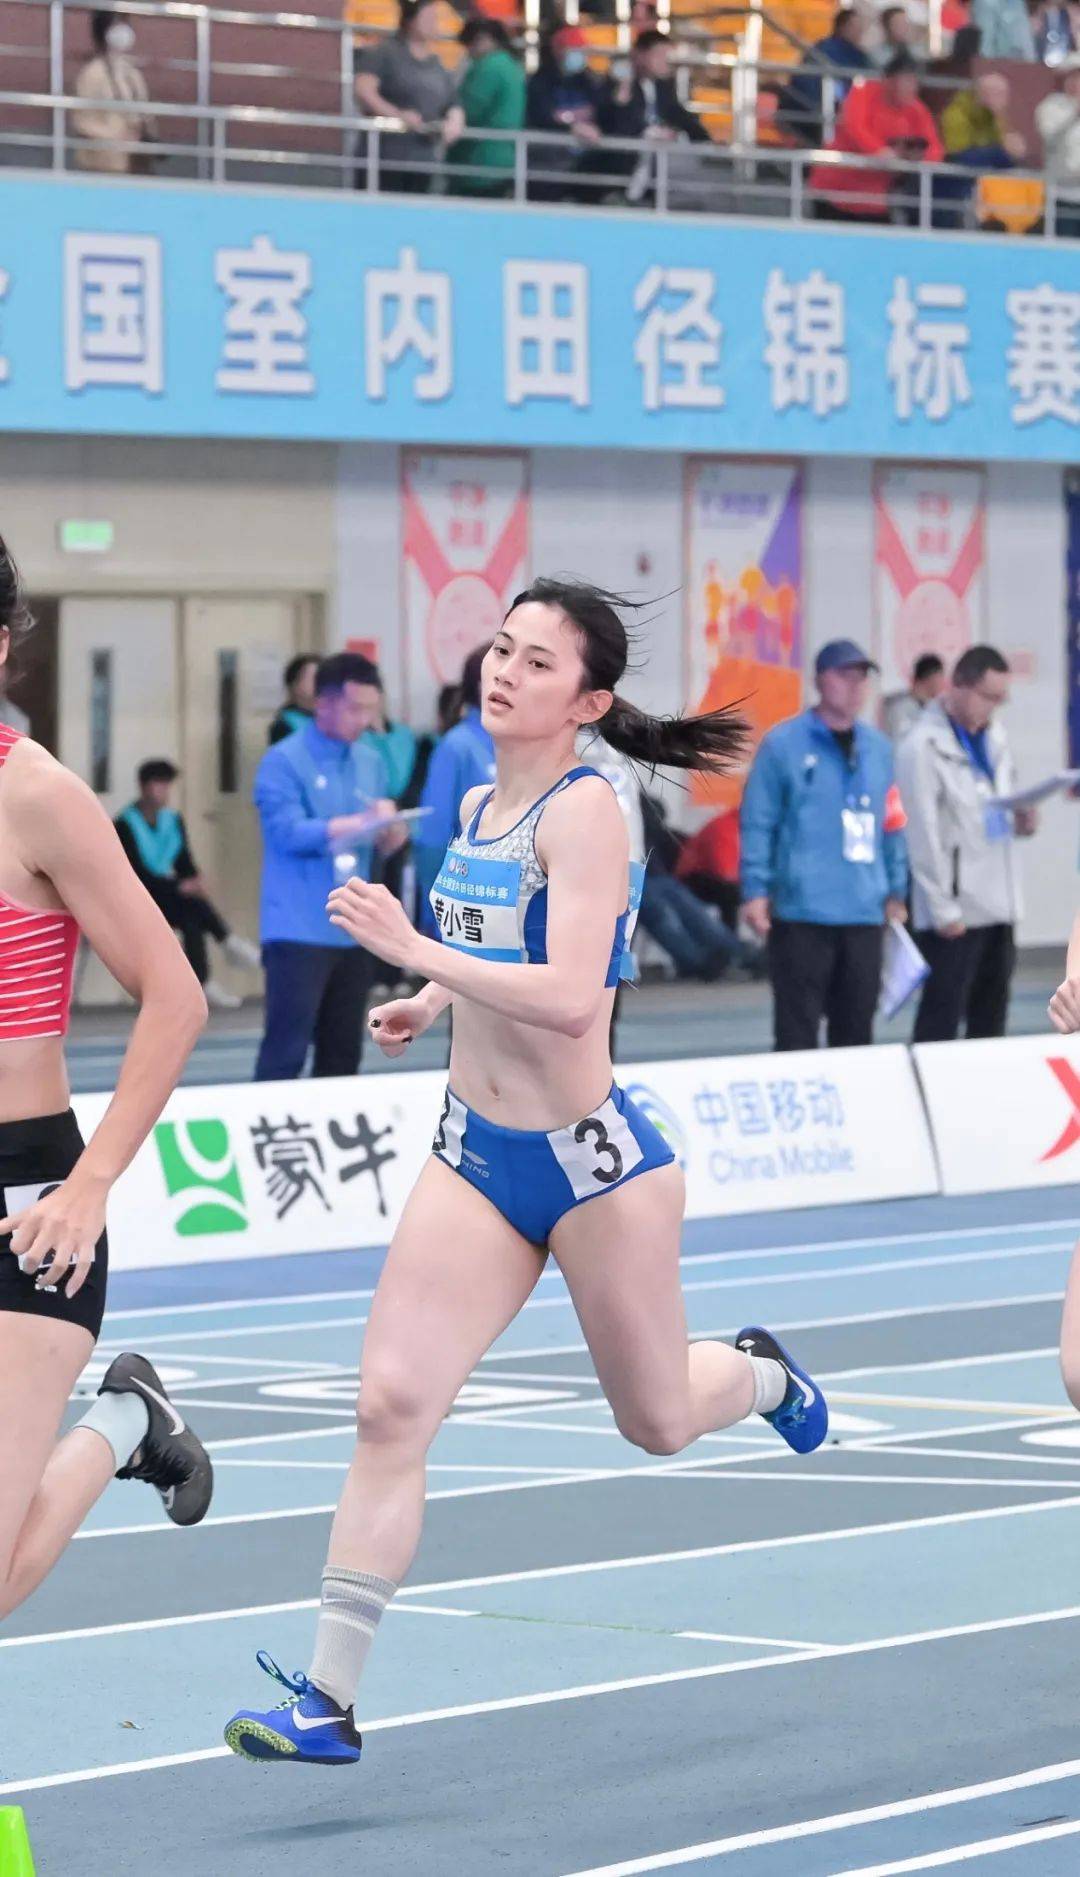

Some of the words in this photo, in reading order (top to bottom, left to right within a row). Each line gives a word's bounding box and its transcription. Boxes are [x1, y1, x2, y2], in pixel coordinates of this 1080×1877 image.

[0, 233, 1080, 428] 国室内田径锦标赛
[693, 1077, 846, 1138] 中国移动
[248, 1111, 397, 1220] 蒙牛
[574, 1117, 624, 1184] 3
[709, 1149, 778, 1184] China
[778, 1144, 854, 1178] Mobile
